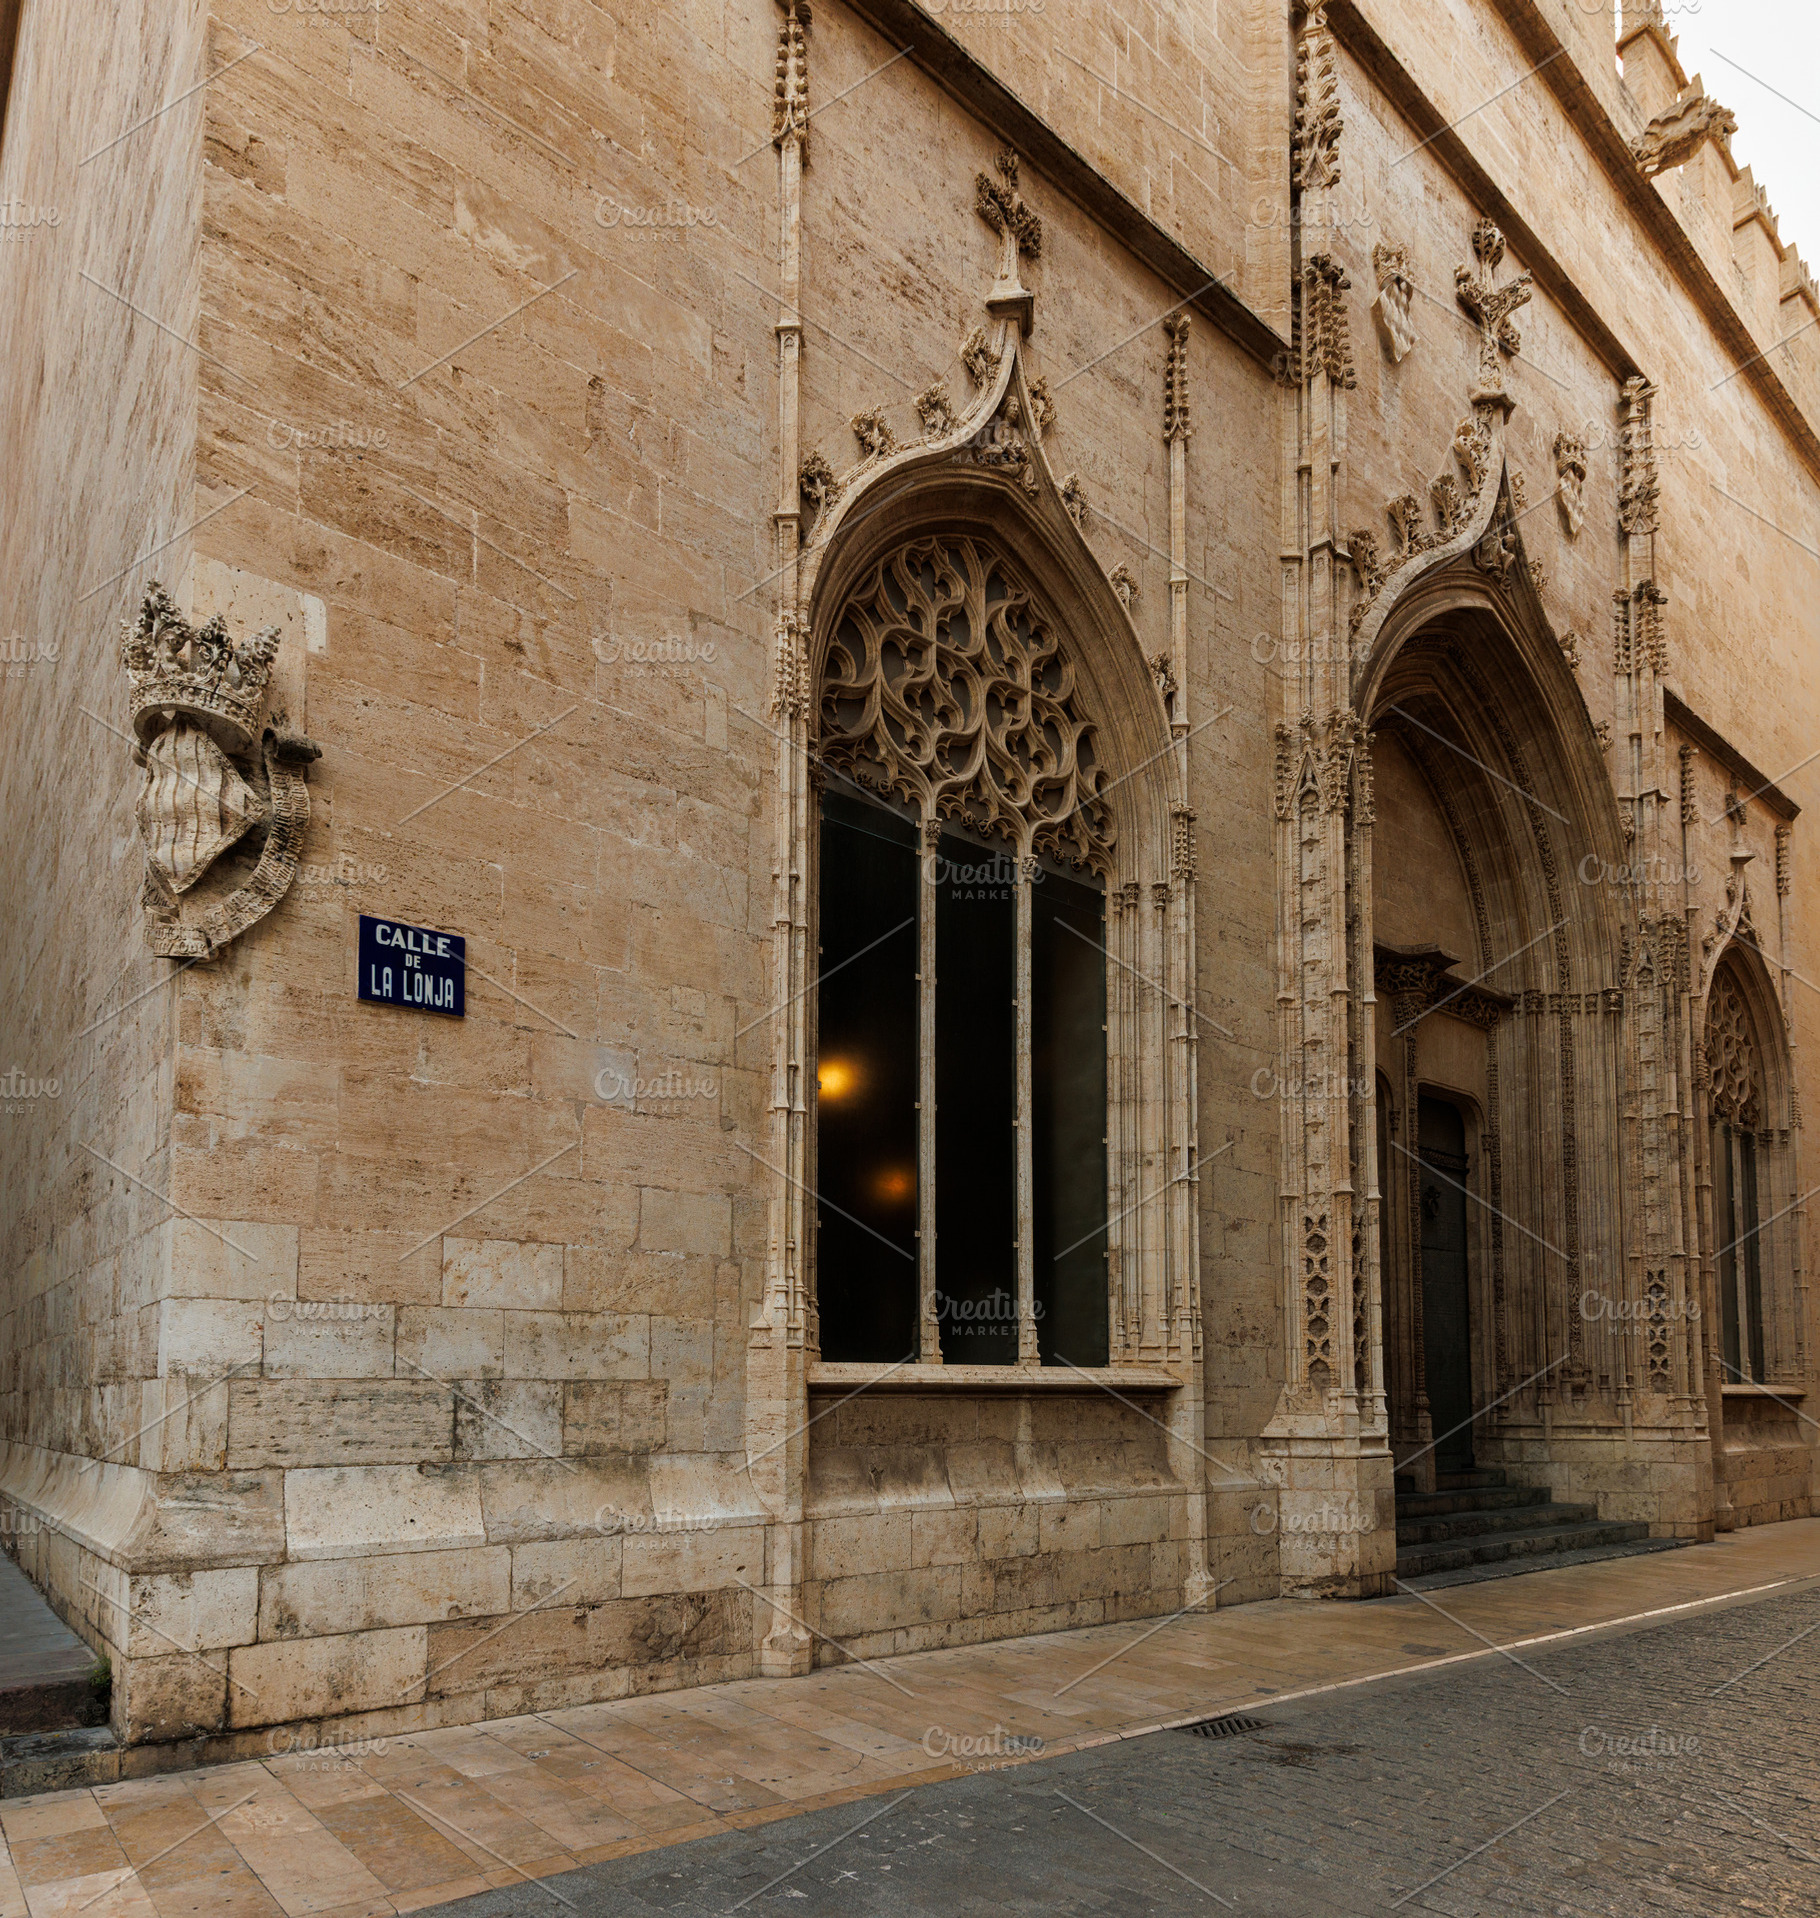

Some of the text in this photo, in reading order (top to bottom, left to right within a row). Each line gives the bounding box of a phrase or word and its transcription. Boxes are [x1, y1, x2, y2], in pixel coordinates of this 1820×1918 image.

[376, 924, 450, 958] CALLE
[405, 953, 421, 969] DE
[371, 964, 454, 1009] LA LONJA
